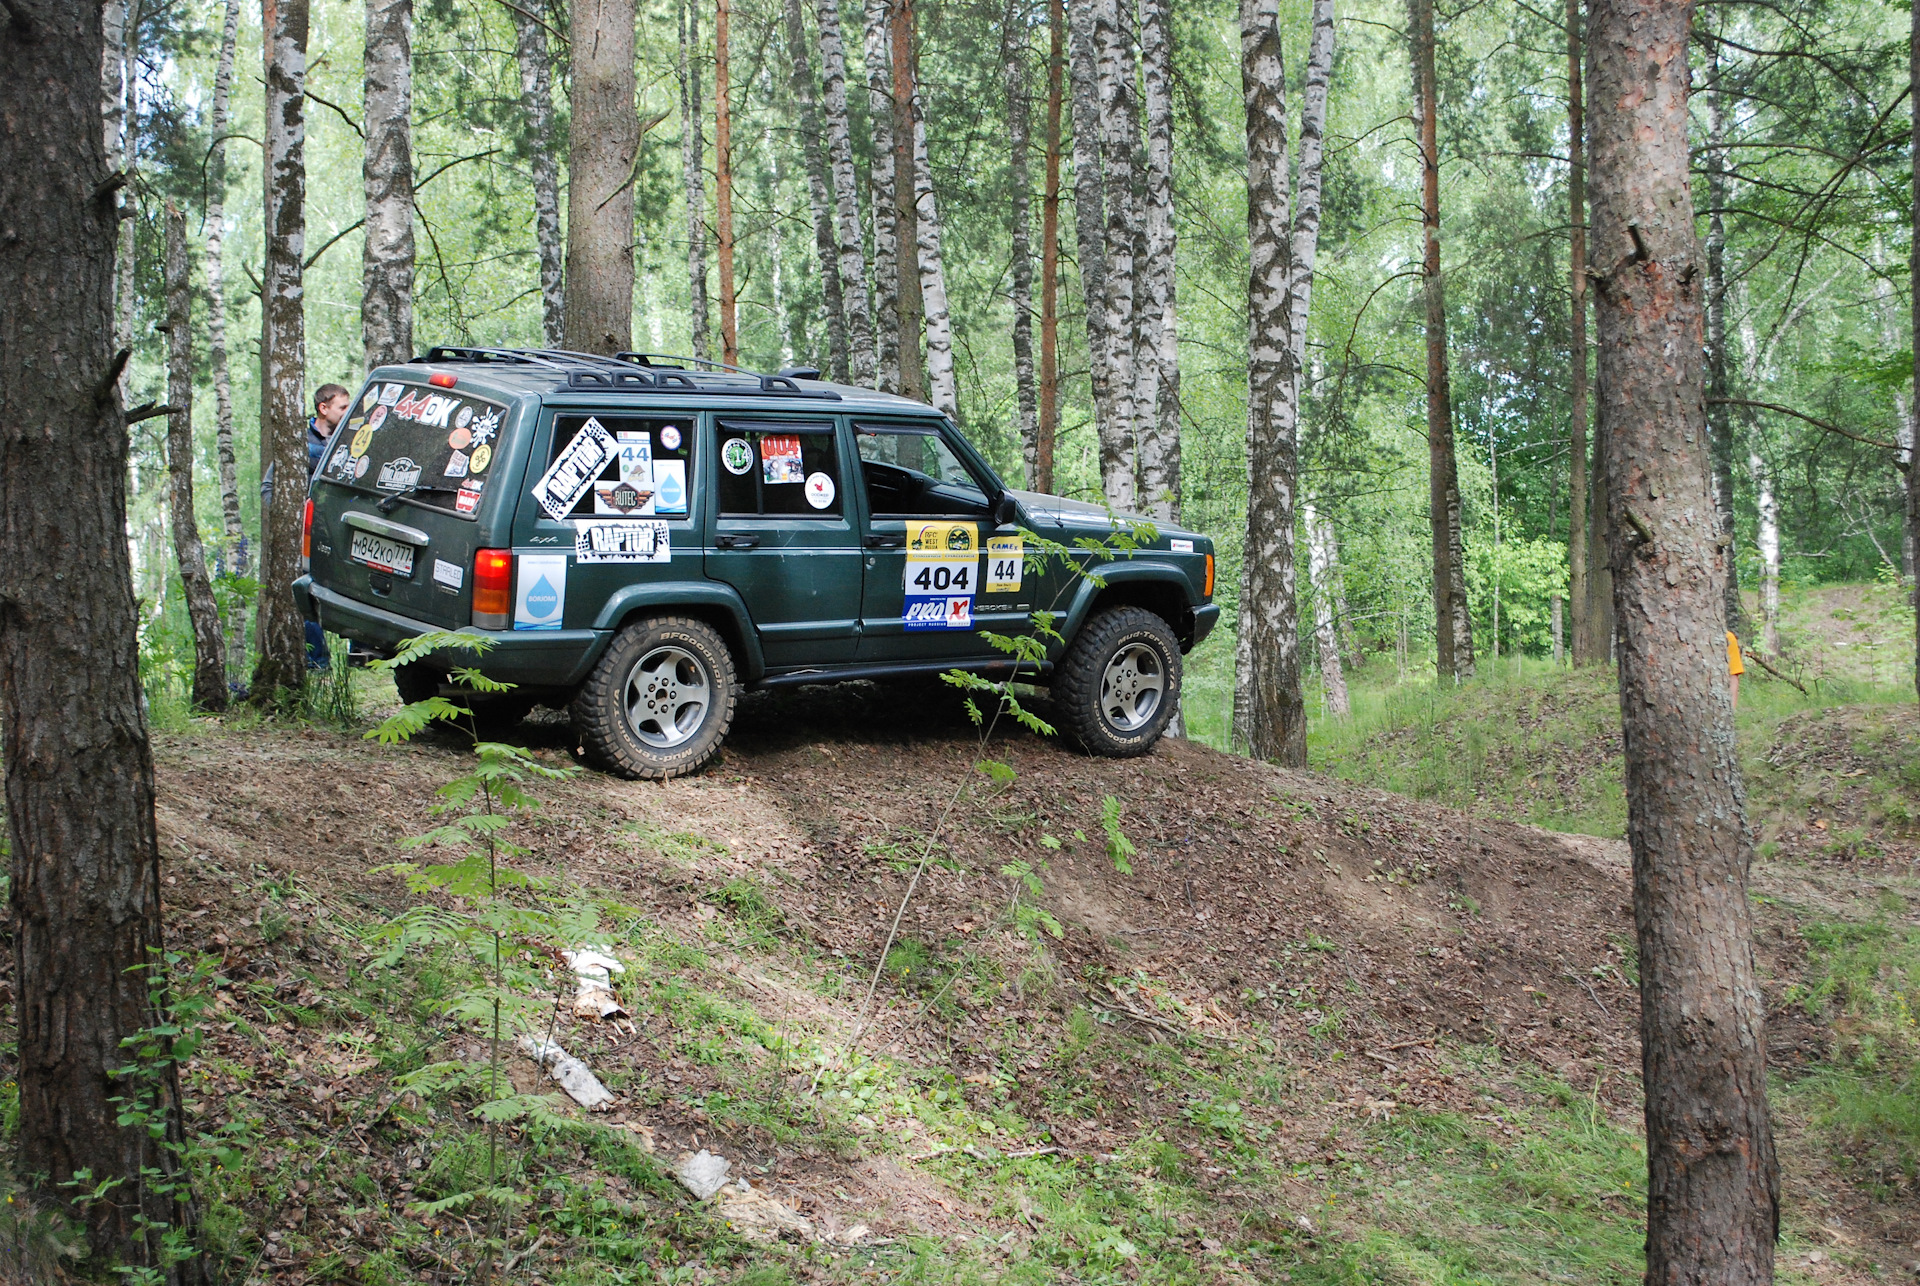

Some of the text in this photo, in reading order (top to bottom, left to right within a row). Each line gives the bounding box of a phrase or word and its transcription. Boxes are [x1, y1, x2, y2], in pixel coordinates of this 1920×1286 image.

[354, 429, 371, 447] 24
[621, 447, 650, 462] 44
[735, 449, 749, 462] 14
[546, 436, 606, 502] RAPTOR
[615, 490, 636, 506] RUTEC
[590, 527, 656, 553] RAPTOR
[395, 545, 412, 562] 777
[914, 567, 969, 590] 404
[995, 560, 1015, 580] 44
[1117, 631, 1172, 664] Mud-Terrain
[660, 632, 723, 689] BFGoodrich
[1094, 700, 1141, 744] BFGoodrich
[617, 720, 693, 763] Mud-Terrain
